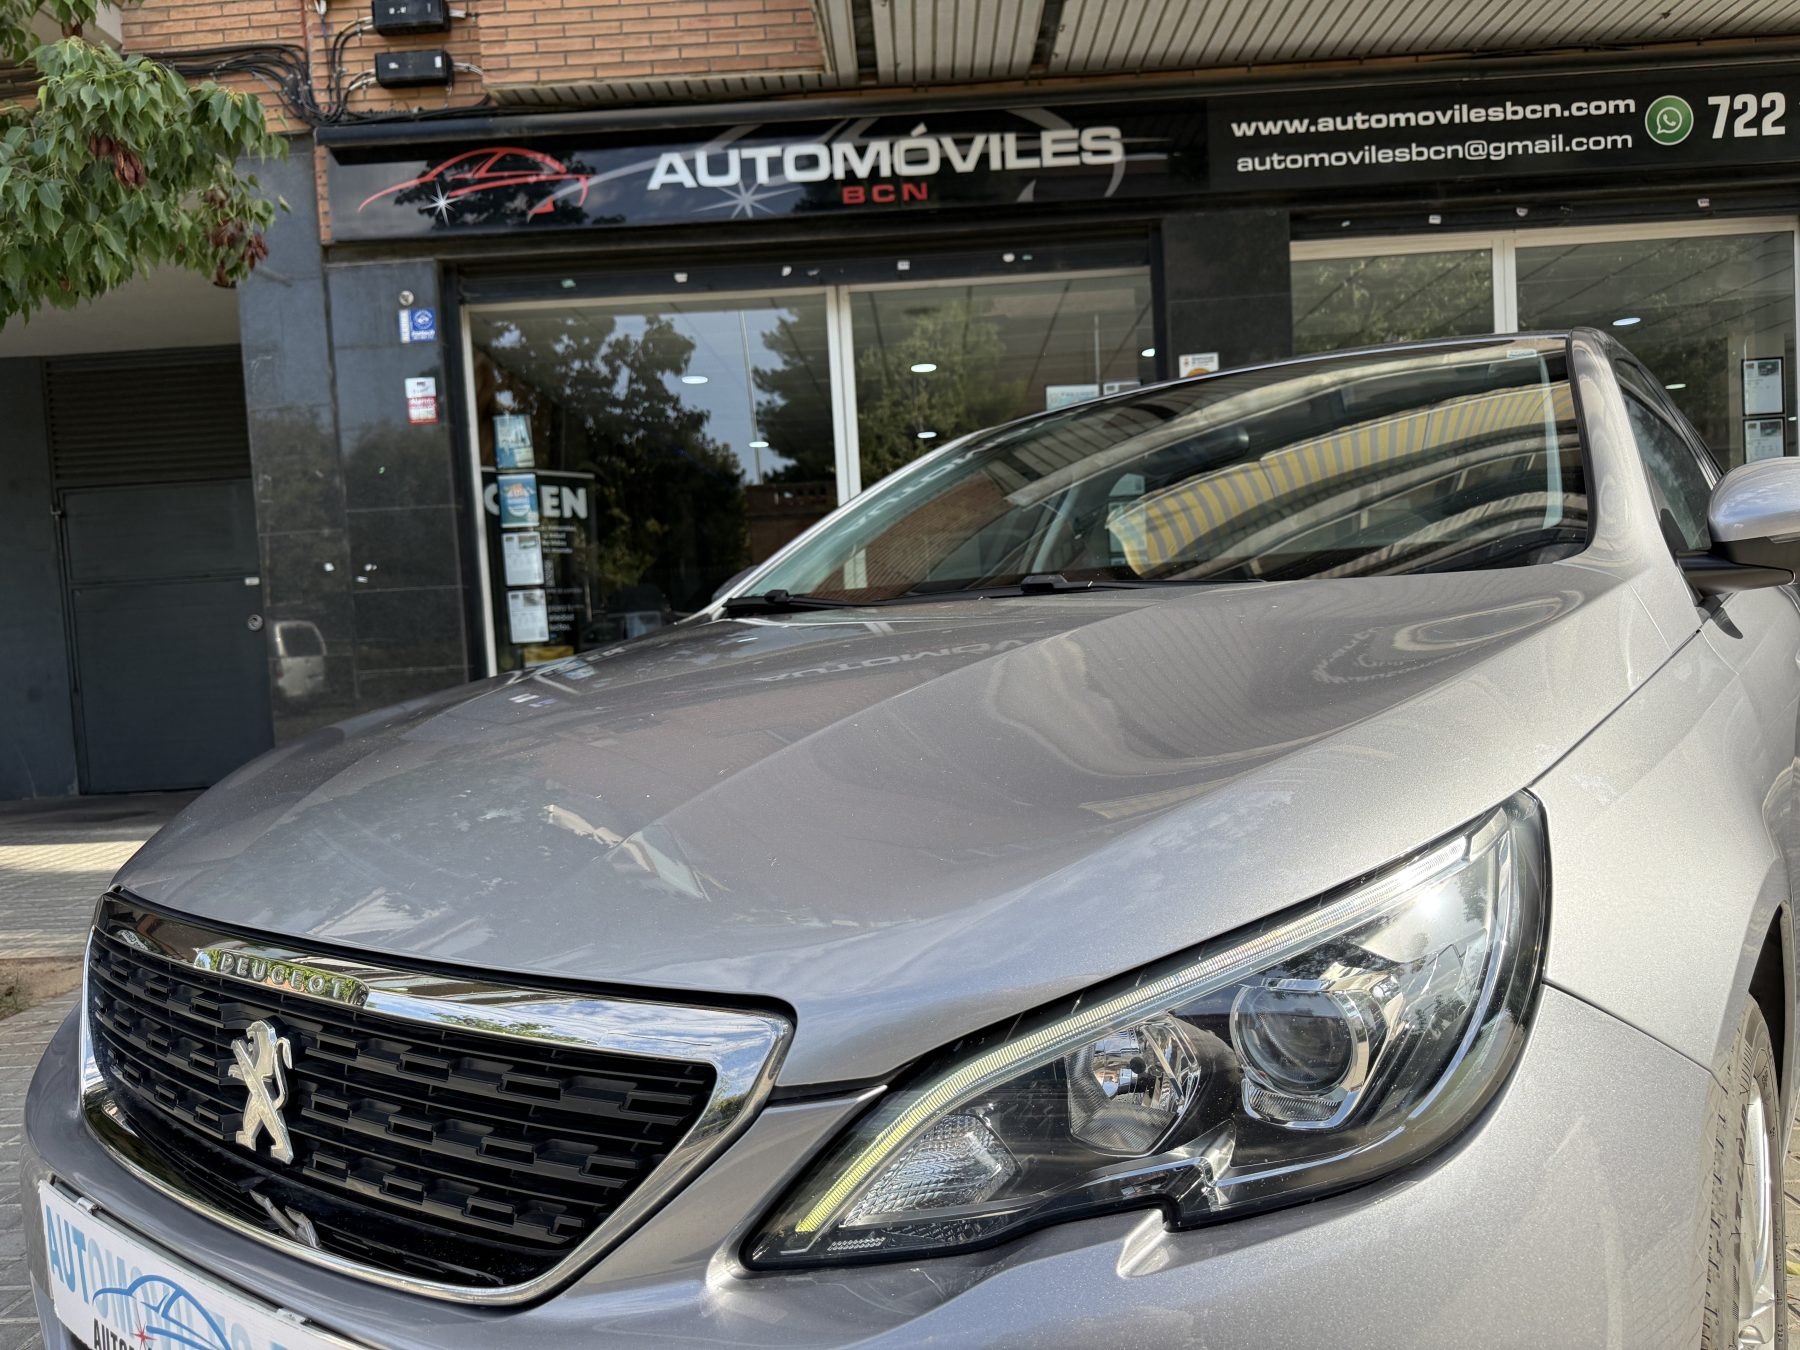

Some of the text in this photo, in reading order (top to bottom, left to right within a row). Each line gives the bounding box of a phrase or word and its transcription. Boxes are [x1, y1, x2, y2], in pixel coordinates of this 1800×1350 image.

[1230, 91, 1786, 140] www.automovilesbcn.com 722
[647, 122, 1123, 190] AUTOMÓVILES
[1236, 131, 1634, 173] automovilesbcn@gmail.com
[842, 182, 928, 205] BCN
[217, 952, 346, 1000] PEUGEOT
